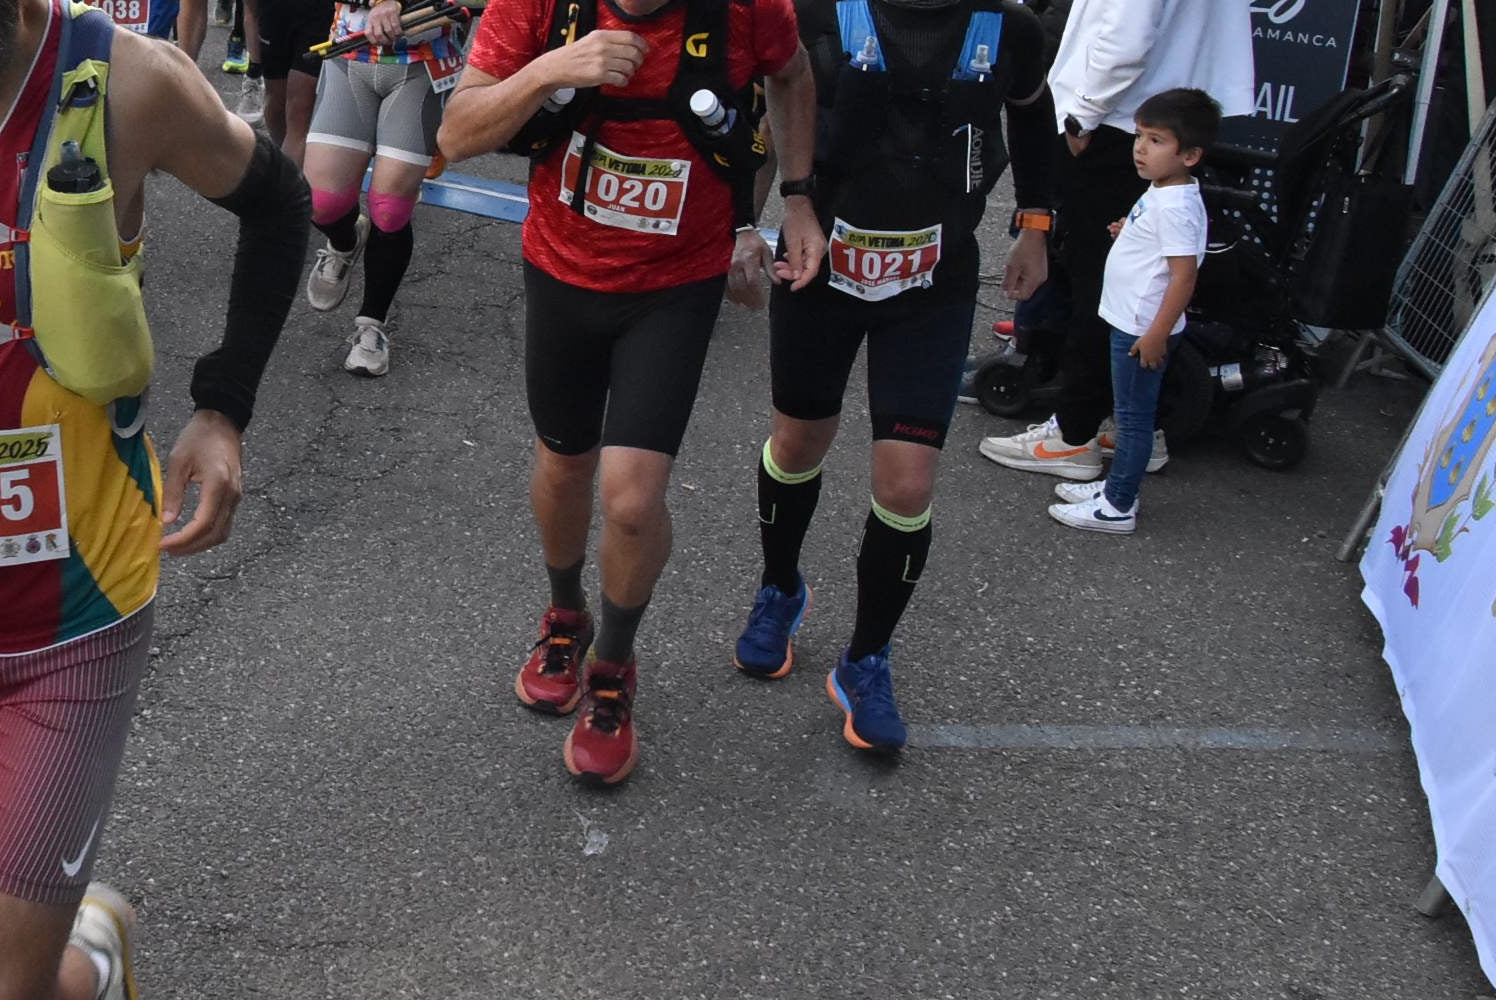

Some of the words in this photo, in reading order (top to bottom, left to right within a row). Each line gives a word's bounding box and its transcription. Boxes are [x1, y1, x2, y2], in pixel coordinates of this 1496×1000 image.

[1253, 26, 1338, 49] AMANCA
[1254, 81, 1300, 123] AIL
[843, 247, 922, 280] 1021
